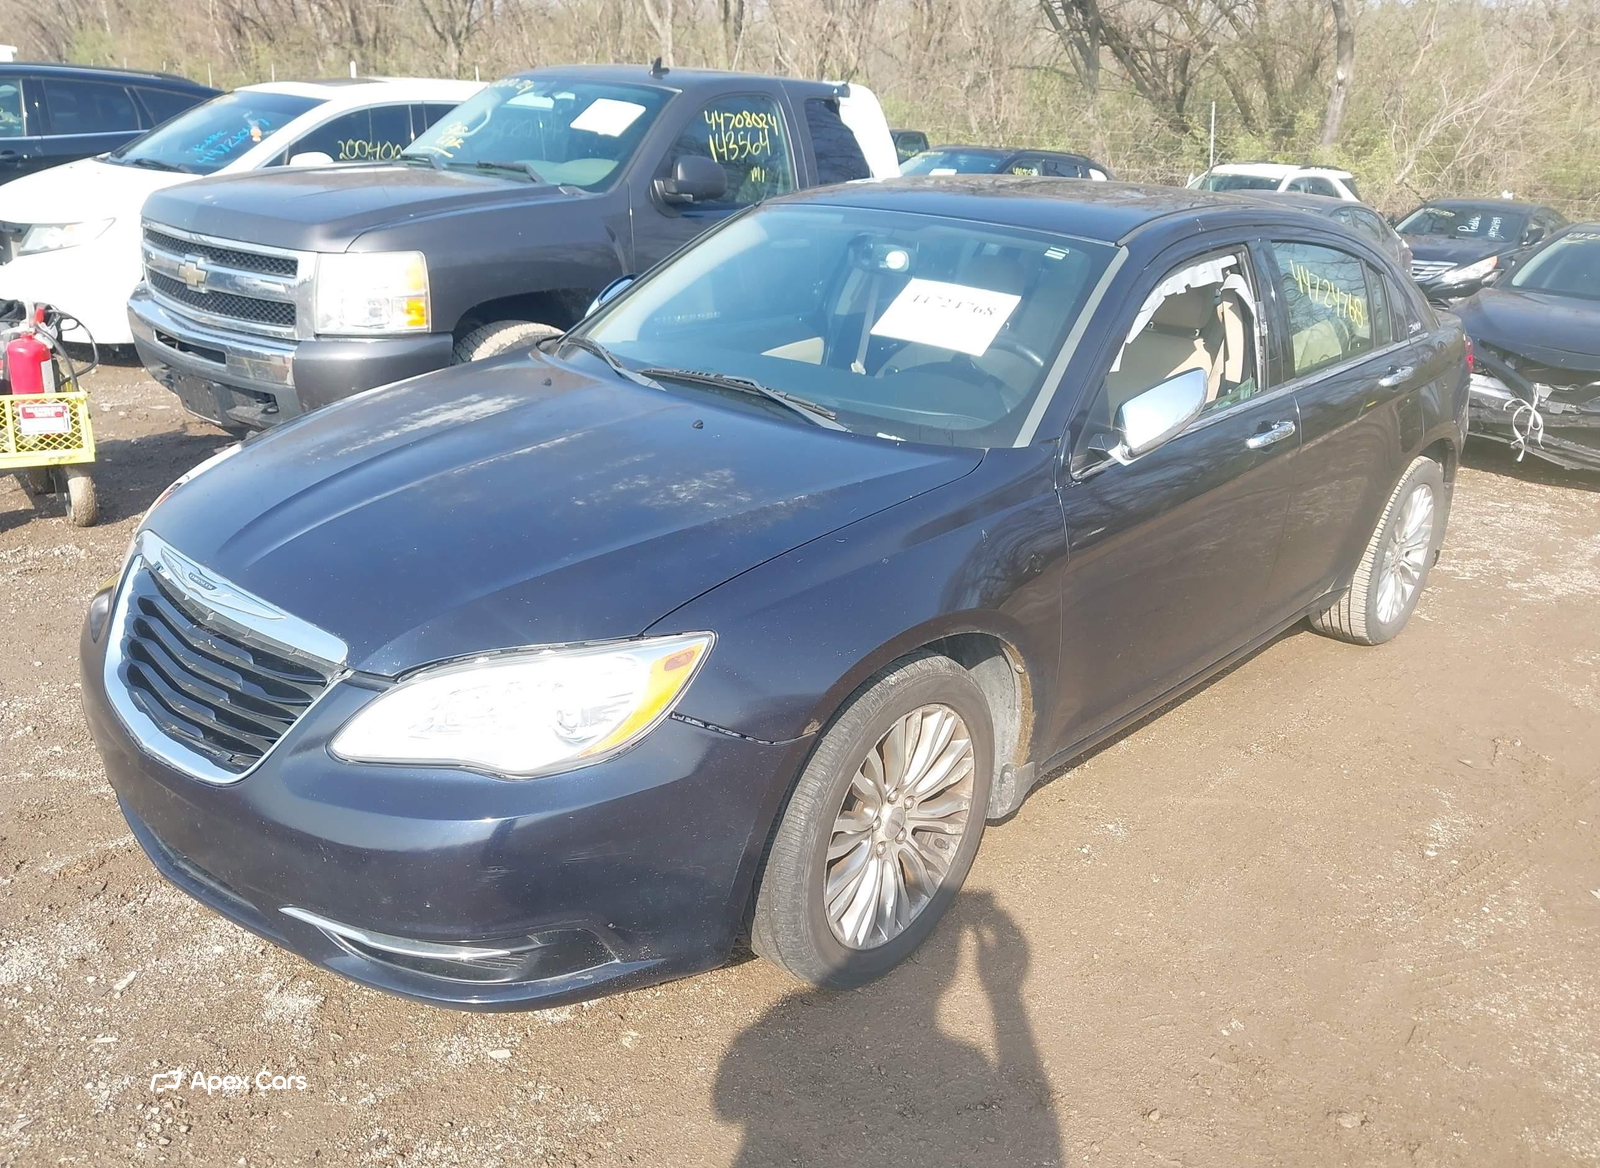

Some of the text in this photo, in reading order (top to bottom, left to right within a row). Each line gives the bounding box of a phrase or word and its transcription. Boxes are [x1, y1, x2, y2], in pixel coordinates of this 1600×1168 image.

[704, 110, 779, 136] 44708024
[708, 128, 771, 163] 143564
[1289, 259, 1364, 329] 44724768
